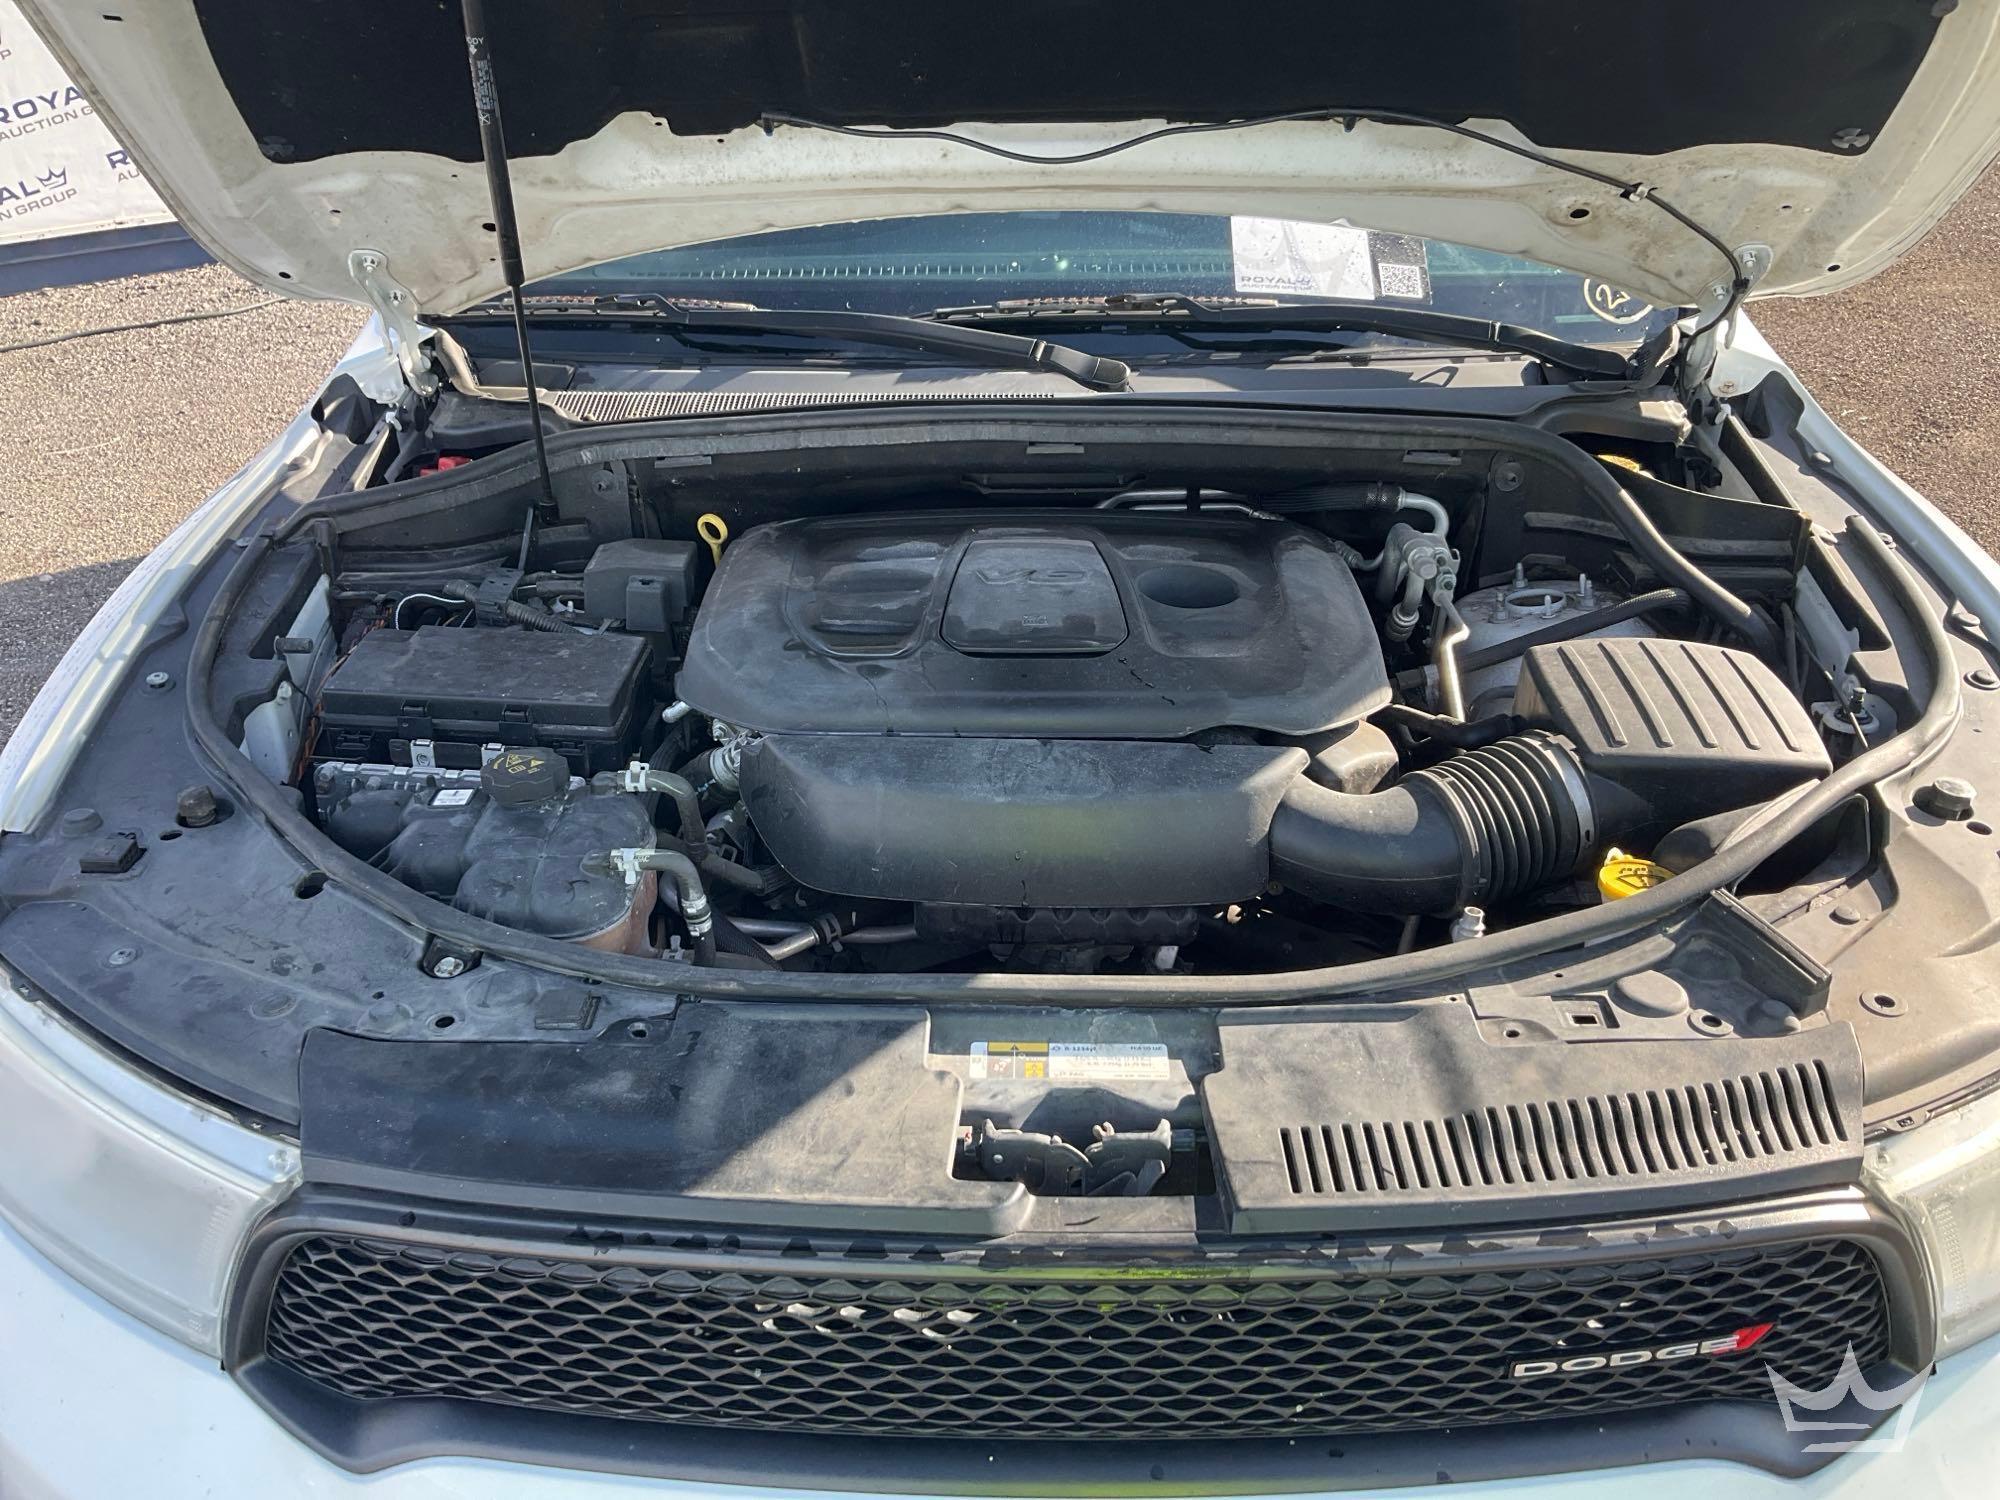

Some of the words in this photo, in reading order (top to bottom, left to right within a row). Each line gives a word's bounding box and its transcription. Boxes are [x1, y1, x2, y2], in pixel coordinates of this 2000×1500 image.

[466, 36, 484, 45] ODY
[0, 109, 79, 140] AUCTION
[14, 187, 78, 216] GROUP
[1241, 275, 1296, 285] ROYAL
[1513, 1335, 1740, 1377] DODGE
